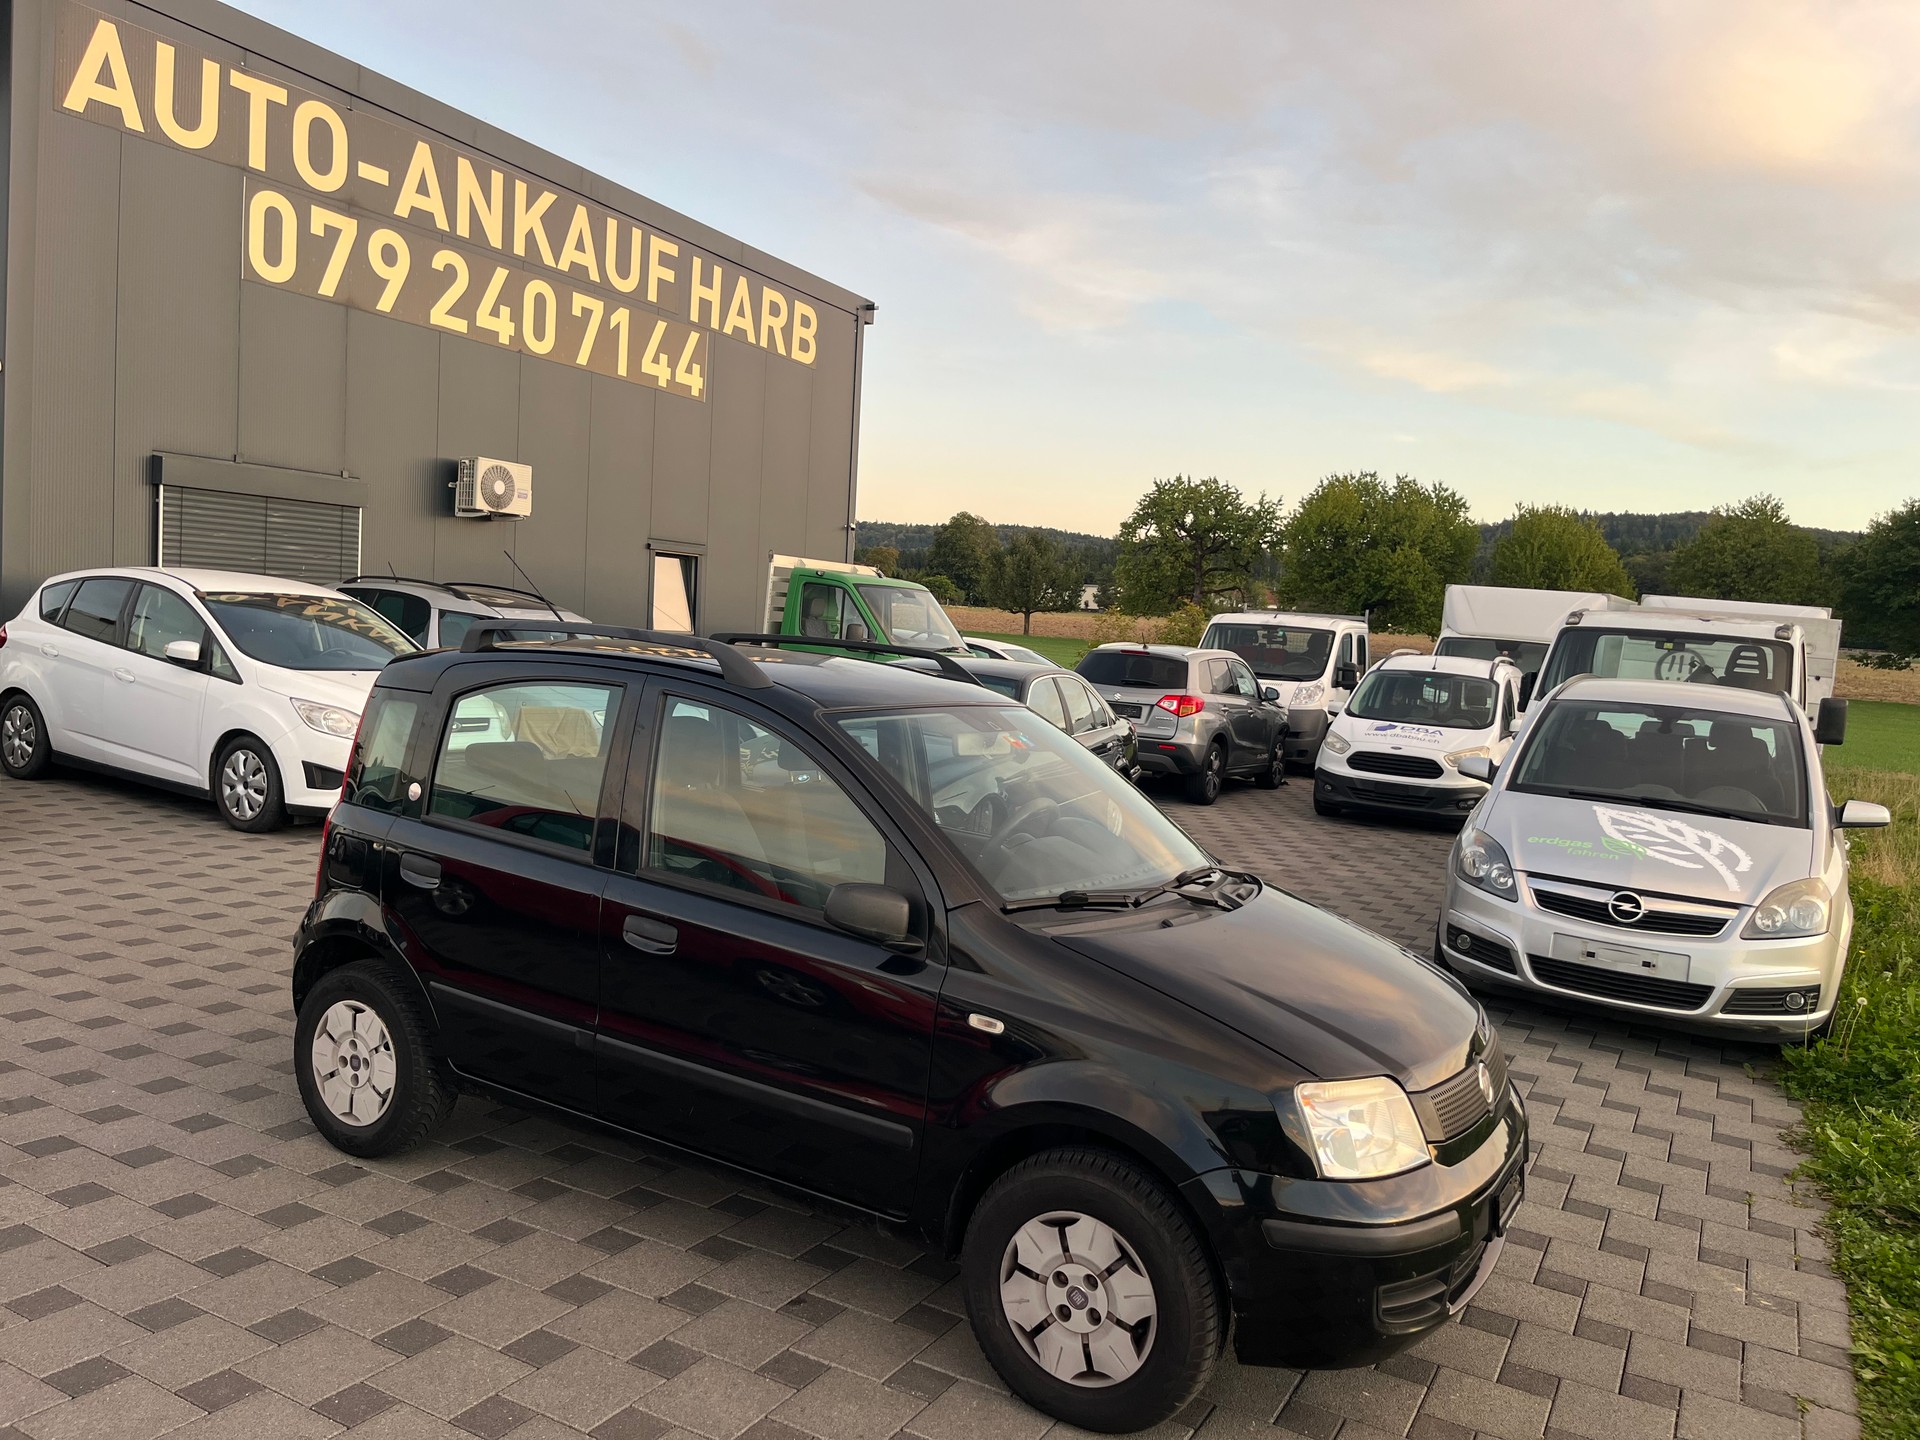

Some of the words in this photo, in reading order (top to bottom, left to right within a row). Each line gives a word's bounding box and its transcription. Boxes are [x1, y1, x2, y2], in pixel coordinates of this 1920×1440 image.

[62, 18, 679, 304] AUTO-ANKAUF
[689, 255, 818, 366] HARB
[248, 190, 411, 313] 079
[429, 249, 557, 355] 240
[570, 291, 704, 397] 7144
[1364, 731, 1440, 744] www.dbabau.ch
[1400, 725, 1444, 737] DBA
[1527, 836, 1593, 849] erdgas
[1567, 848, 1619, 860] fahren
